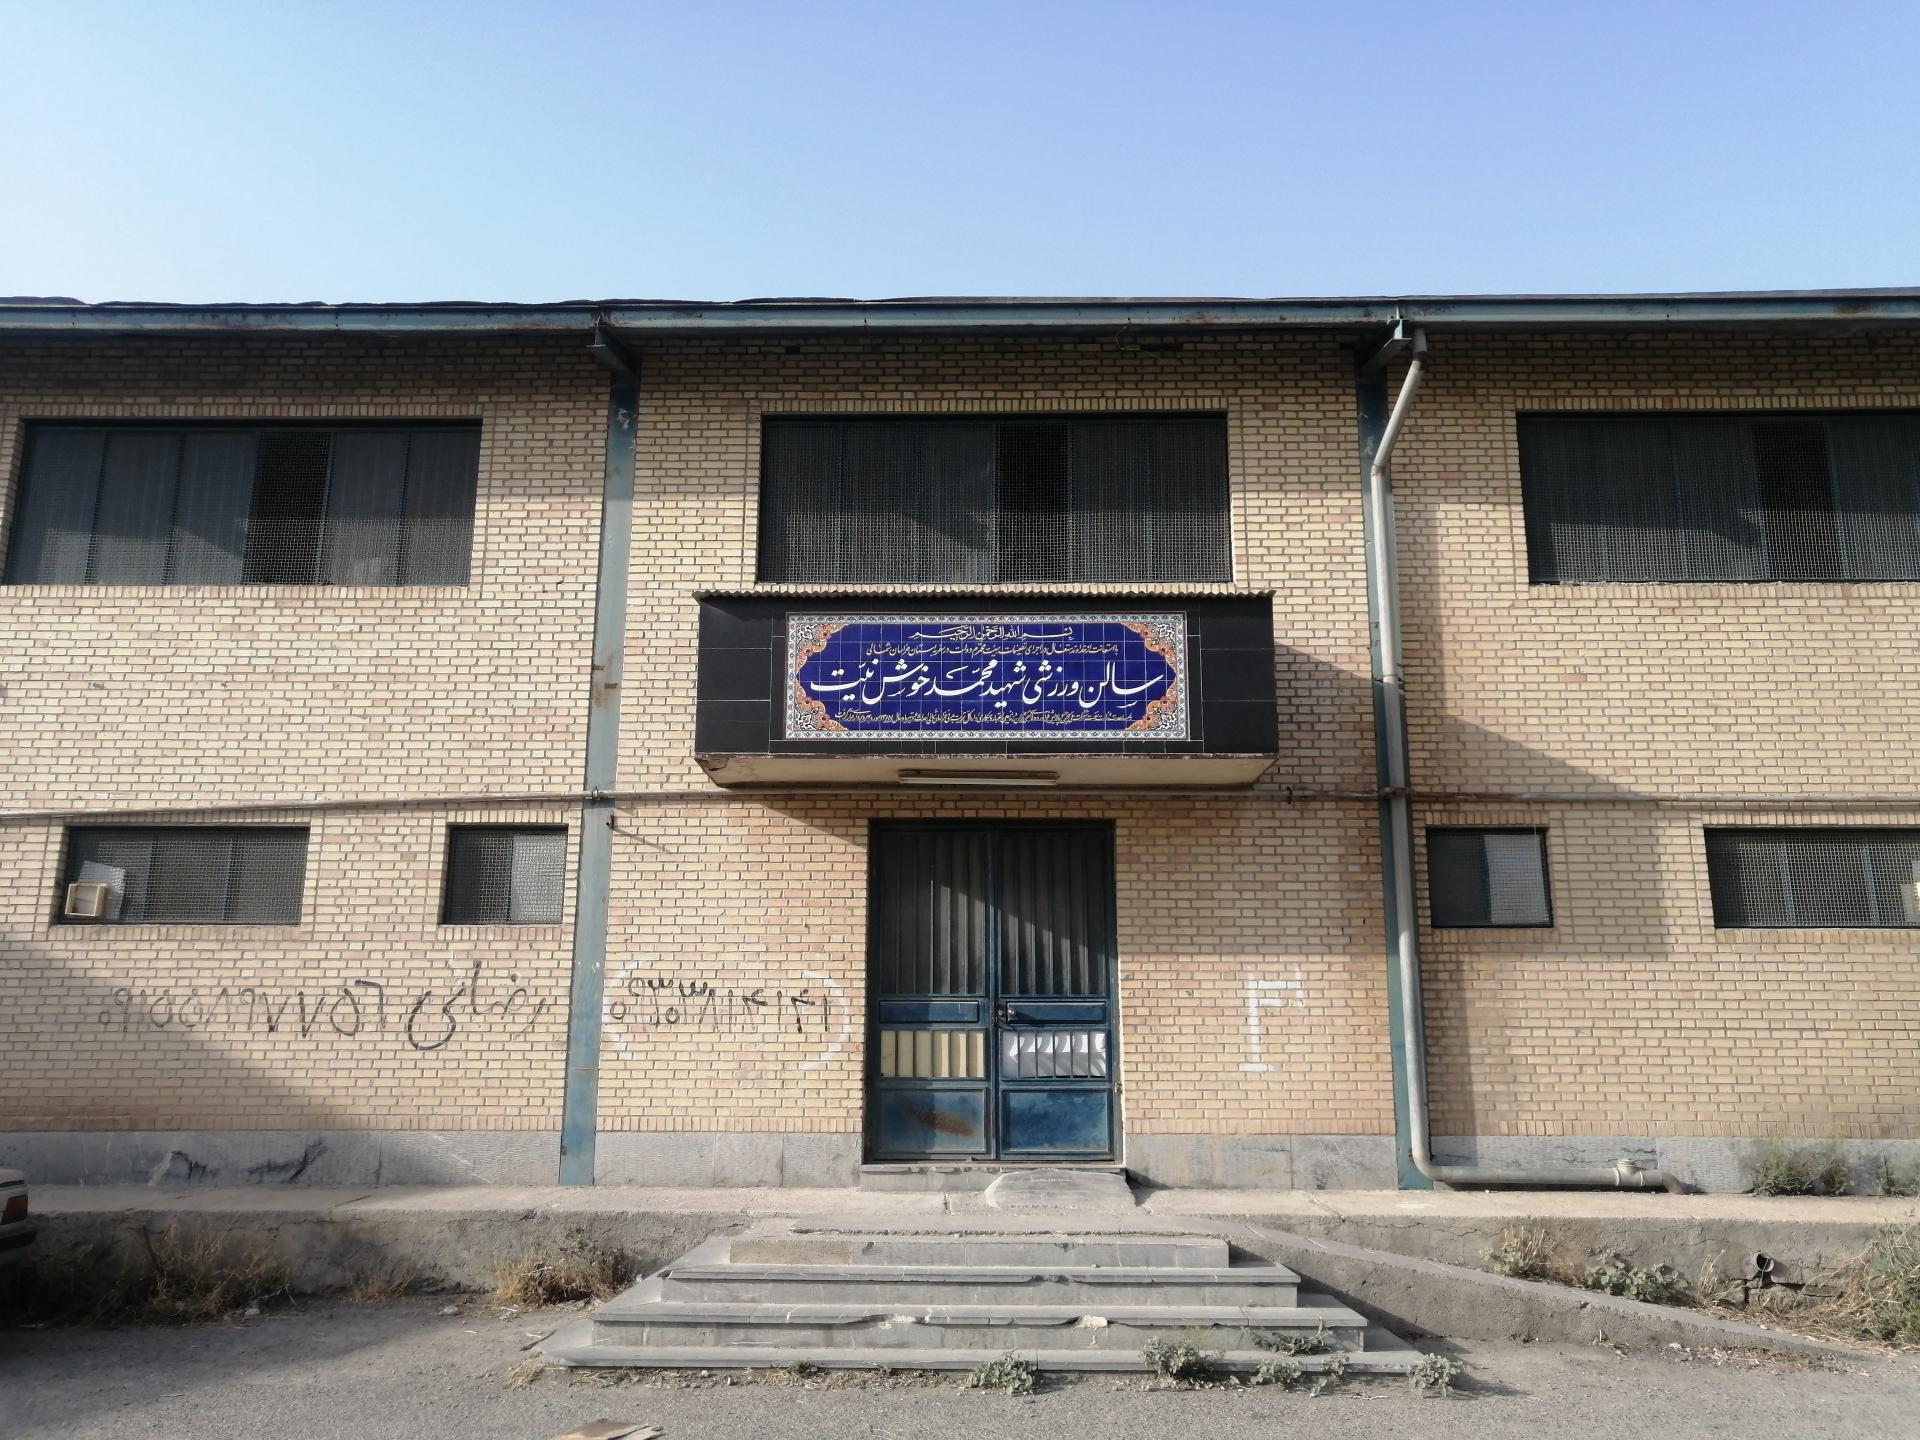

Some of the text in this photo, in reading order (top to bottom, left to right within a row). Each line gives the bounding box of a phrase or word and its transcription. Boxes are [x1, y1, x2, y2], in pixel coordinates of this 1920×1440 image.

[865, 641, 892, 656] شمالی
[861, 658, 931, 706] خوش
[979, 660, 1028, 708] شهید
[1022, 659, 1079, 705] ورزشی
[1079, 660, 1164, 709] سالن
